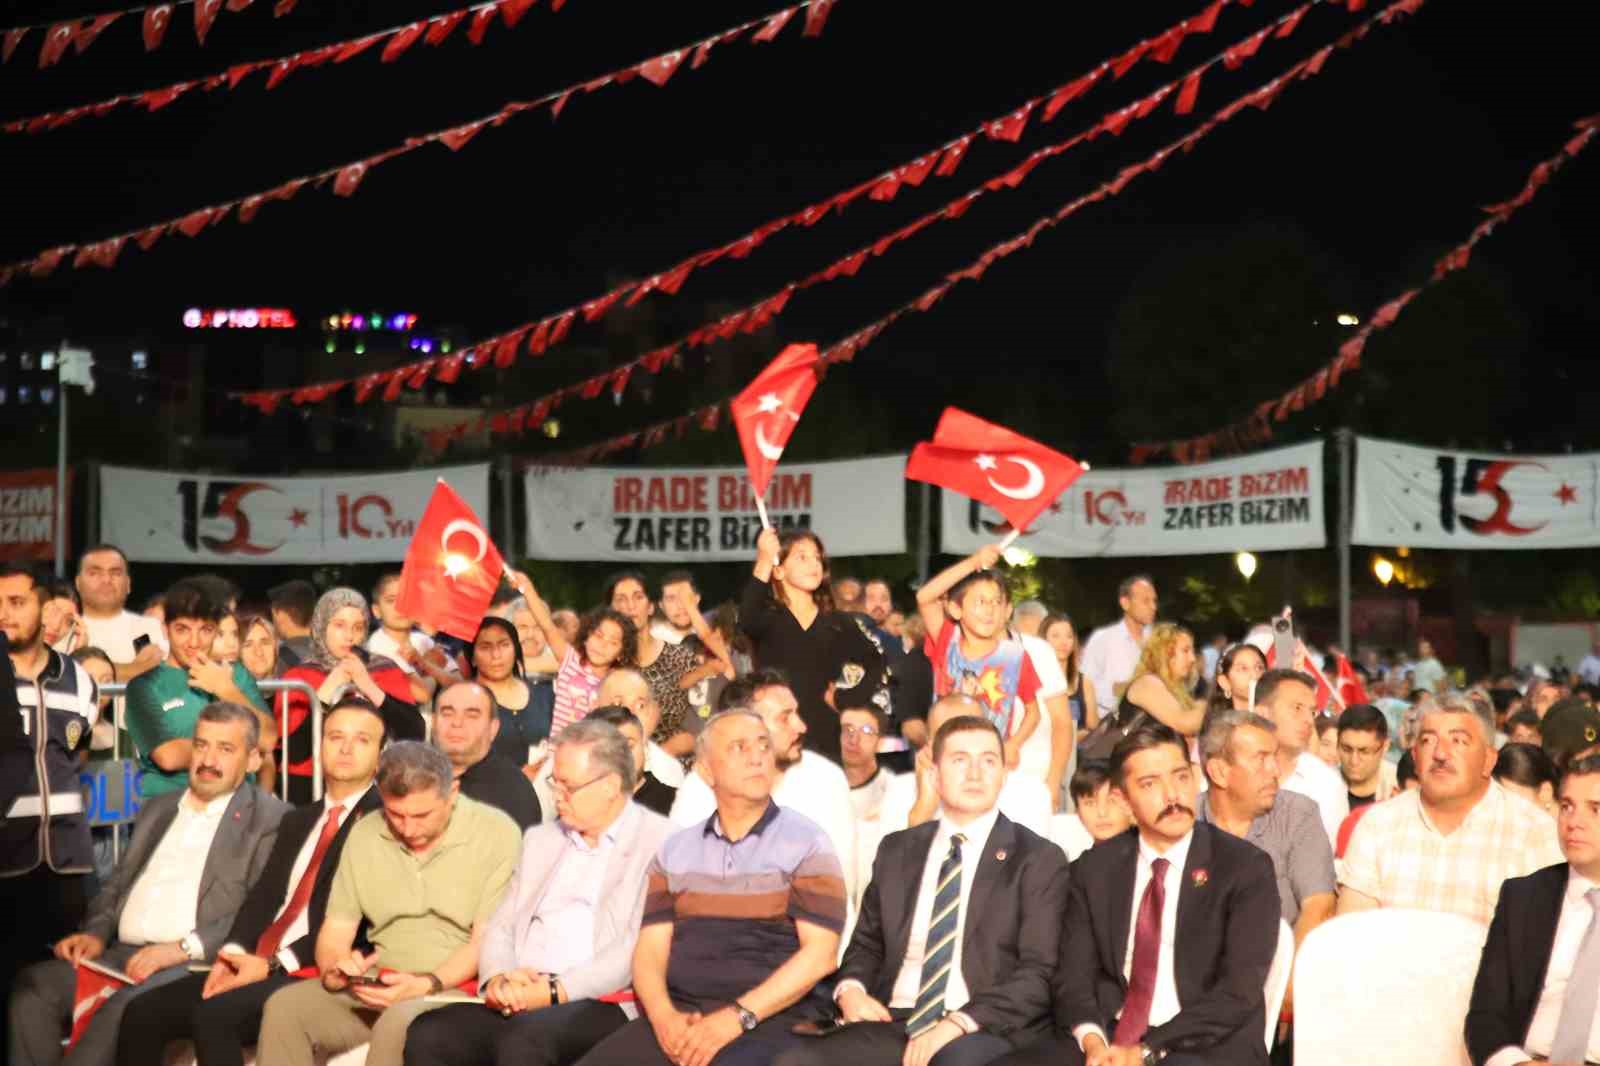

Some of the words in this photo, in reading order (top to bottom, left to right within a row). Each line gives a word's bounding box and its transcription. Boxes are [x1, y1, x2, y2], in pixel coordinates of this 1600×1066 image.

[717, 473, 811, 512] BİİM
[613, 516, 711, 551] ZAFER
[1163, 503, 1234, 531] ZAFER
